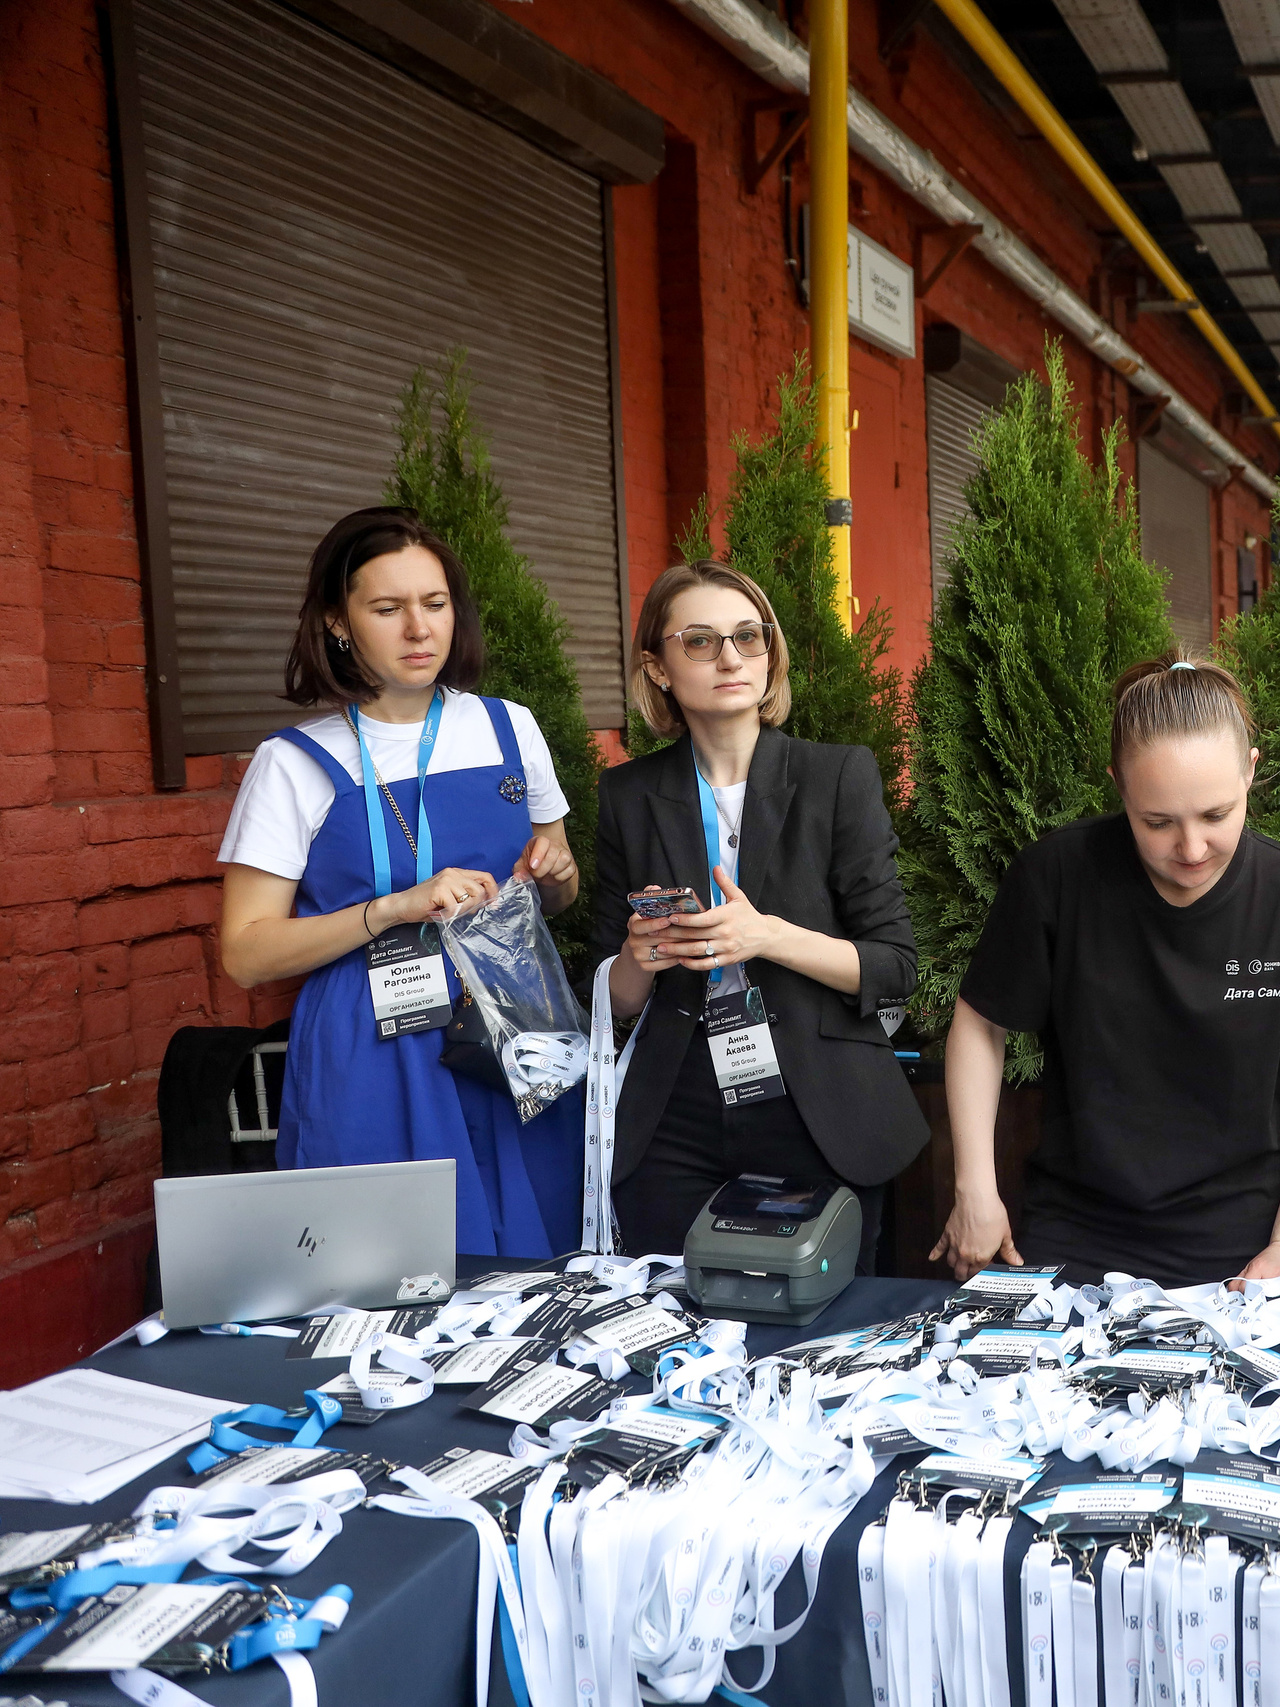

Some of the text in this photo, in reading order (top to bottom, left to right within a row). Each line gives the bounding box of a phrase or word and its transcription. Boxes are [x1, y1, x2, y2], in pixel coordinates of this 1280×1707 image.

[371, 946, 413, 960] Дата Саммит
[391, 964, 420, 976] Юлия
[384, 973, 431, 988] Рагозина
[406, 988, 424, 996] Group
[1224, 988, 1254, 1000] Дата
[390, 999, 434, 1012] ОРГАНИЗАТОР
[708, 1020, 720, 1028] Дата
[728, 1034, 749, 1045] Анна
[565, 1050, 574, 1059] DIS
[726, 1043, 756, 1056] Акаева
[742, 1057, 756, 1065] Group
[729, 1069, 766, 1081] ОРГАНИЗАТОР
[617, 1320, 667, 1344] Богданов
[621, 1325, 677, 1350] Александр
[1119, 1362, 1184, 1370] Екатерина
[1123, 1358, 1190, 1366] Прохорова
[518, 1373, 571, 1412] Гончарова
[537, 1381, 574, 1409] Галина
[380, 1396, 394, 1404] DIS
[613, 1403, 627, 1411] DIS
[982, 1408, 996, 1418] DIS
[945, 1437, 958, 1447] DIS
[1205, 1497, 1269, 1512] Дмитрий
[1222, 1512, 1261, 1525] Саммит
[865, 1567, 873, 1582] DIS
[1034, 1591, 1042, 1606] DIS
[1214, 1587, 1223, 1603] DIS
[1130, 1615, 1138, 1630] DIS
[1190, 1612, 1199, 1627] DIS
[1250, 1615, 1258, 1630] DIS
[877, 1687, 886, 1702] DIS
